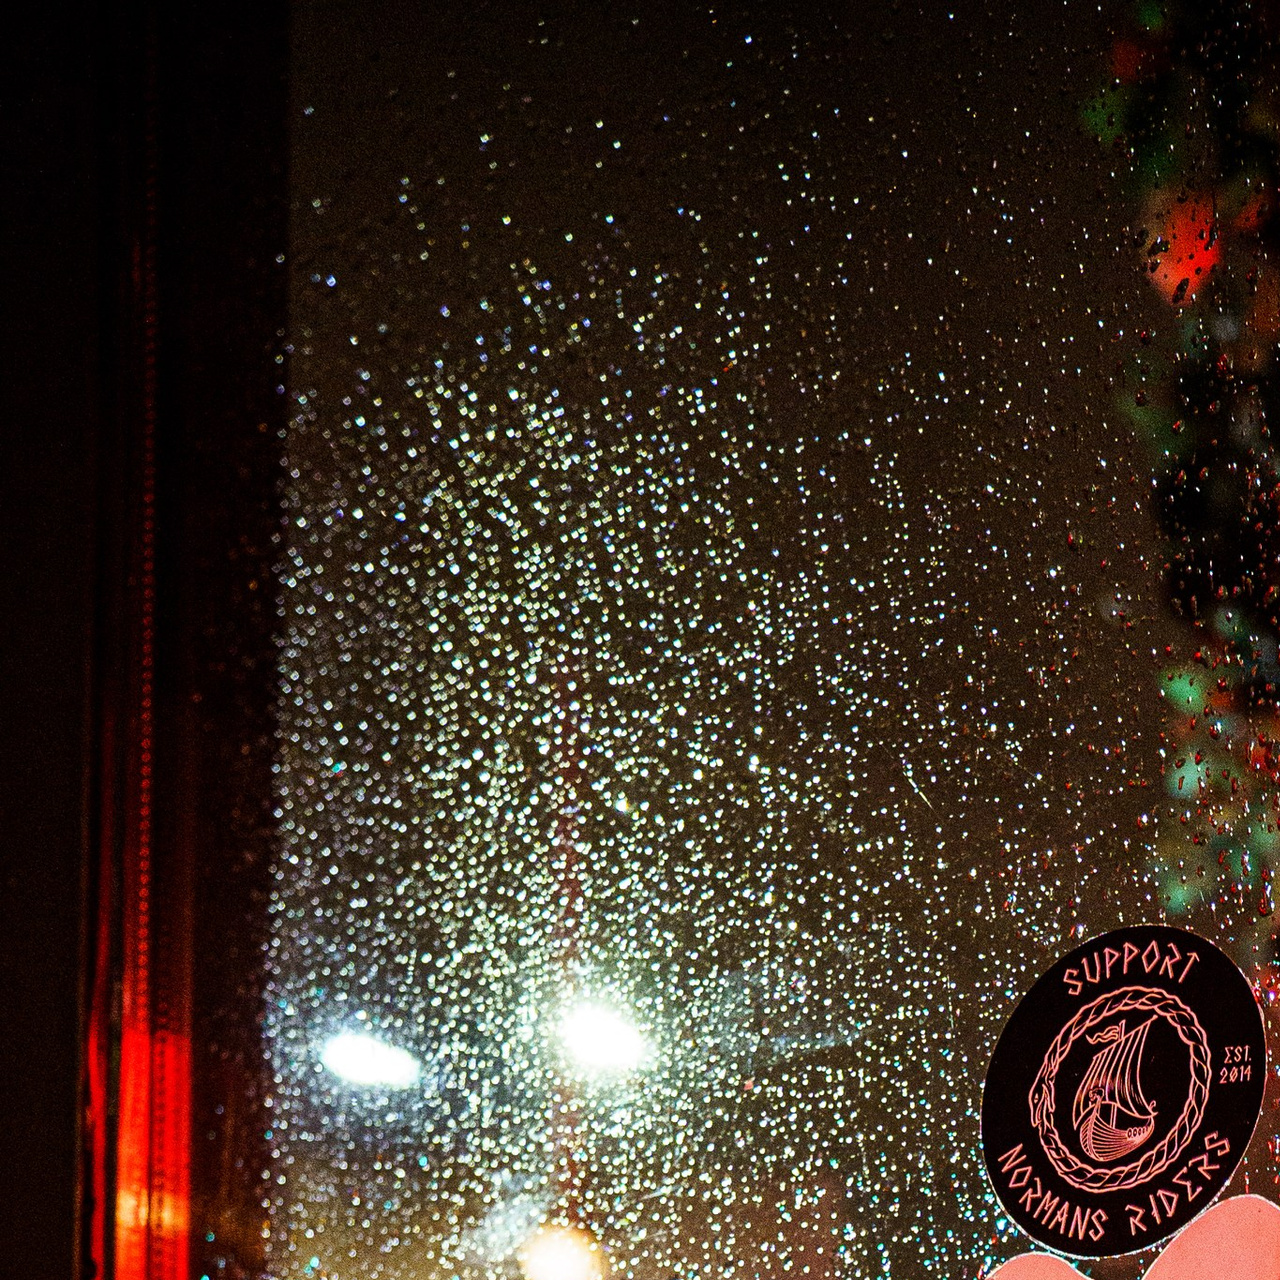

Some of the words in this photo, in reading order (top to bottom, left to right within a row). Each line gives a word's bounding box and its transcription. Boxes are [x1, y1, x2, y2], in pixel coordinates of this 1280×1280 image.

[1063, 940, 1200, 996] SUPPORT
[1219, 1064, 1252, 1085] 2014
[997, 1142, 1109, 1242] NORMANS
[1124, 1130, 1231, 1236] RIDERS
